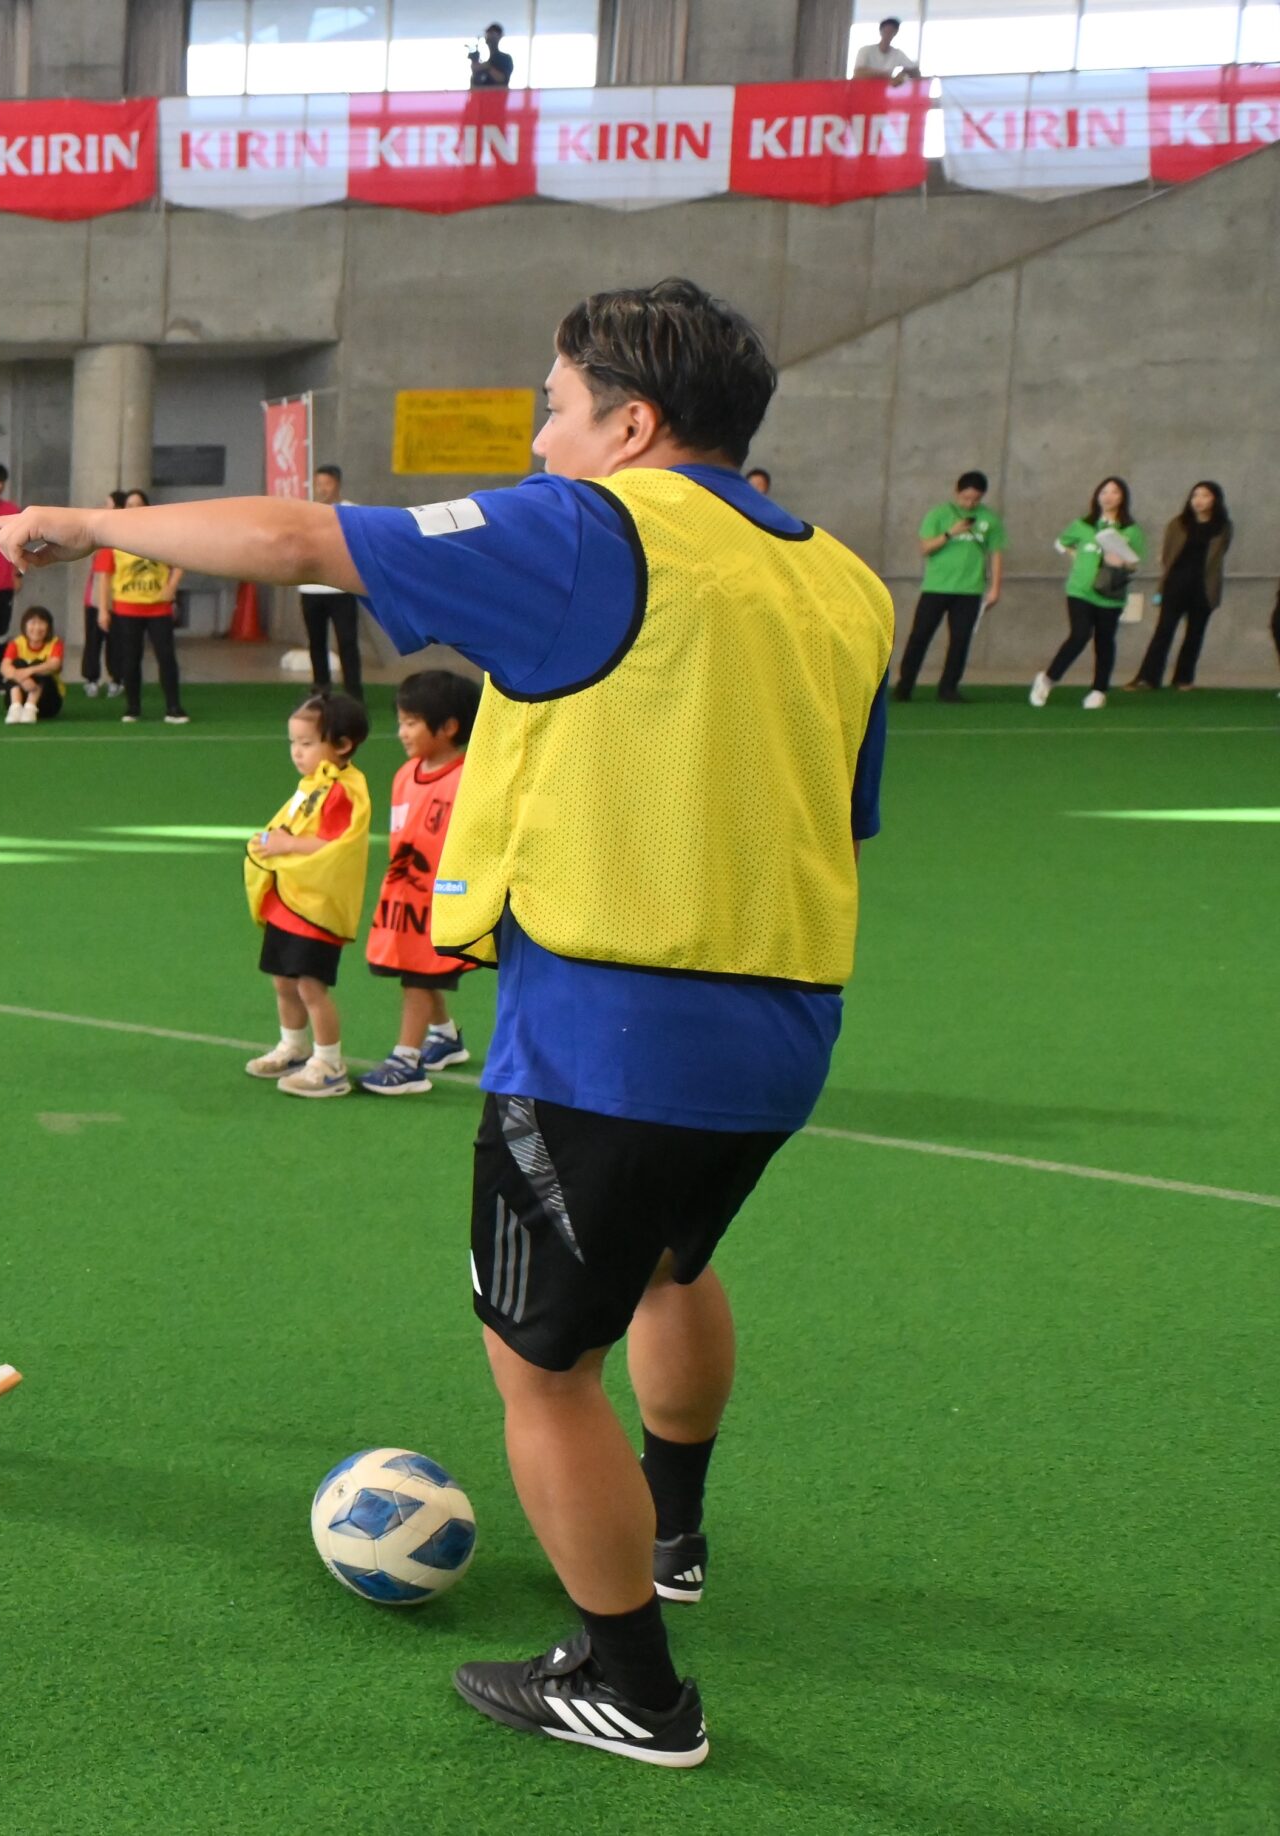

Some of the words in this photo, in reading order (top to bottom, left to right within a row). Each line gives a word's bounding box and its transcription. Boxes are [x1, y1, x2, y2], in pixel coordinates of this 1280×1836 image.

[557, 121, 711, 163] KIRIN
[748, 114, 910, 160] KIRIN
[962, 107, 1127, 150] KIRIN
[1169, 103, 1280, 145] KIR
[180, 130, 328, 170] KIRIN
[365, 123, 518, 168] KIRIN
